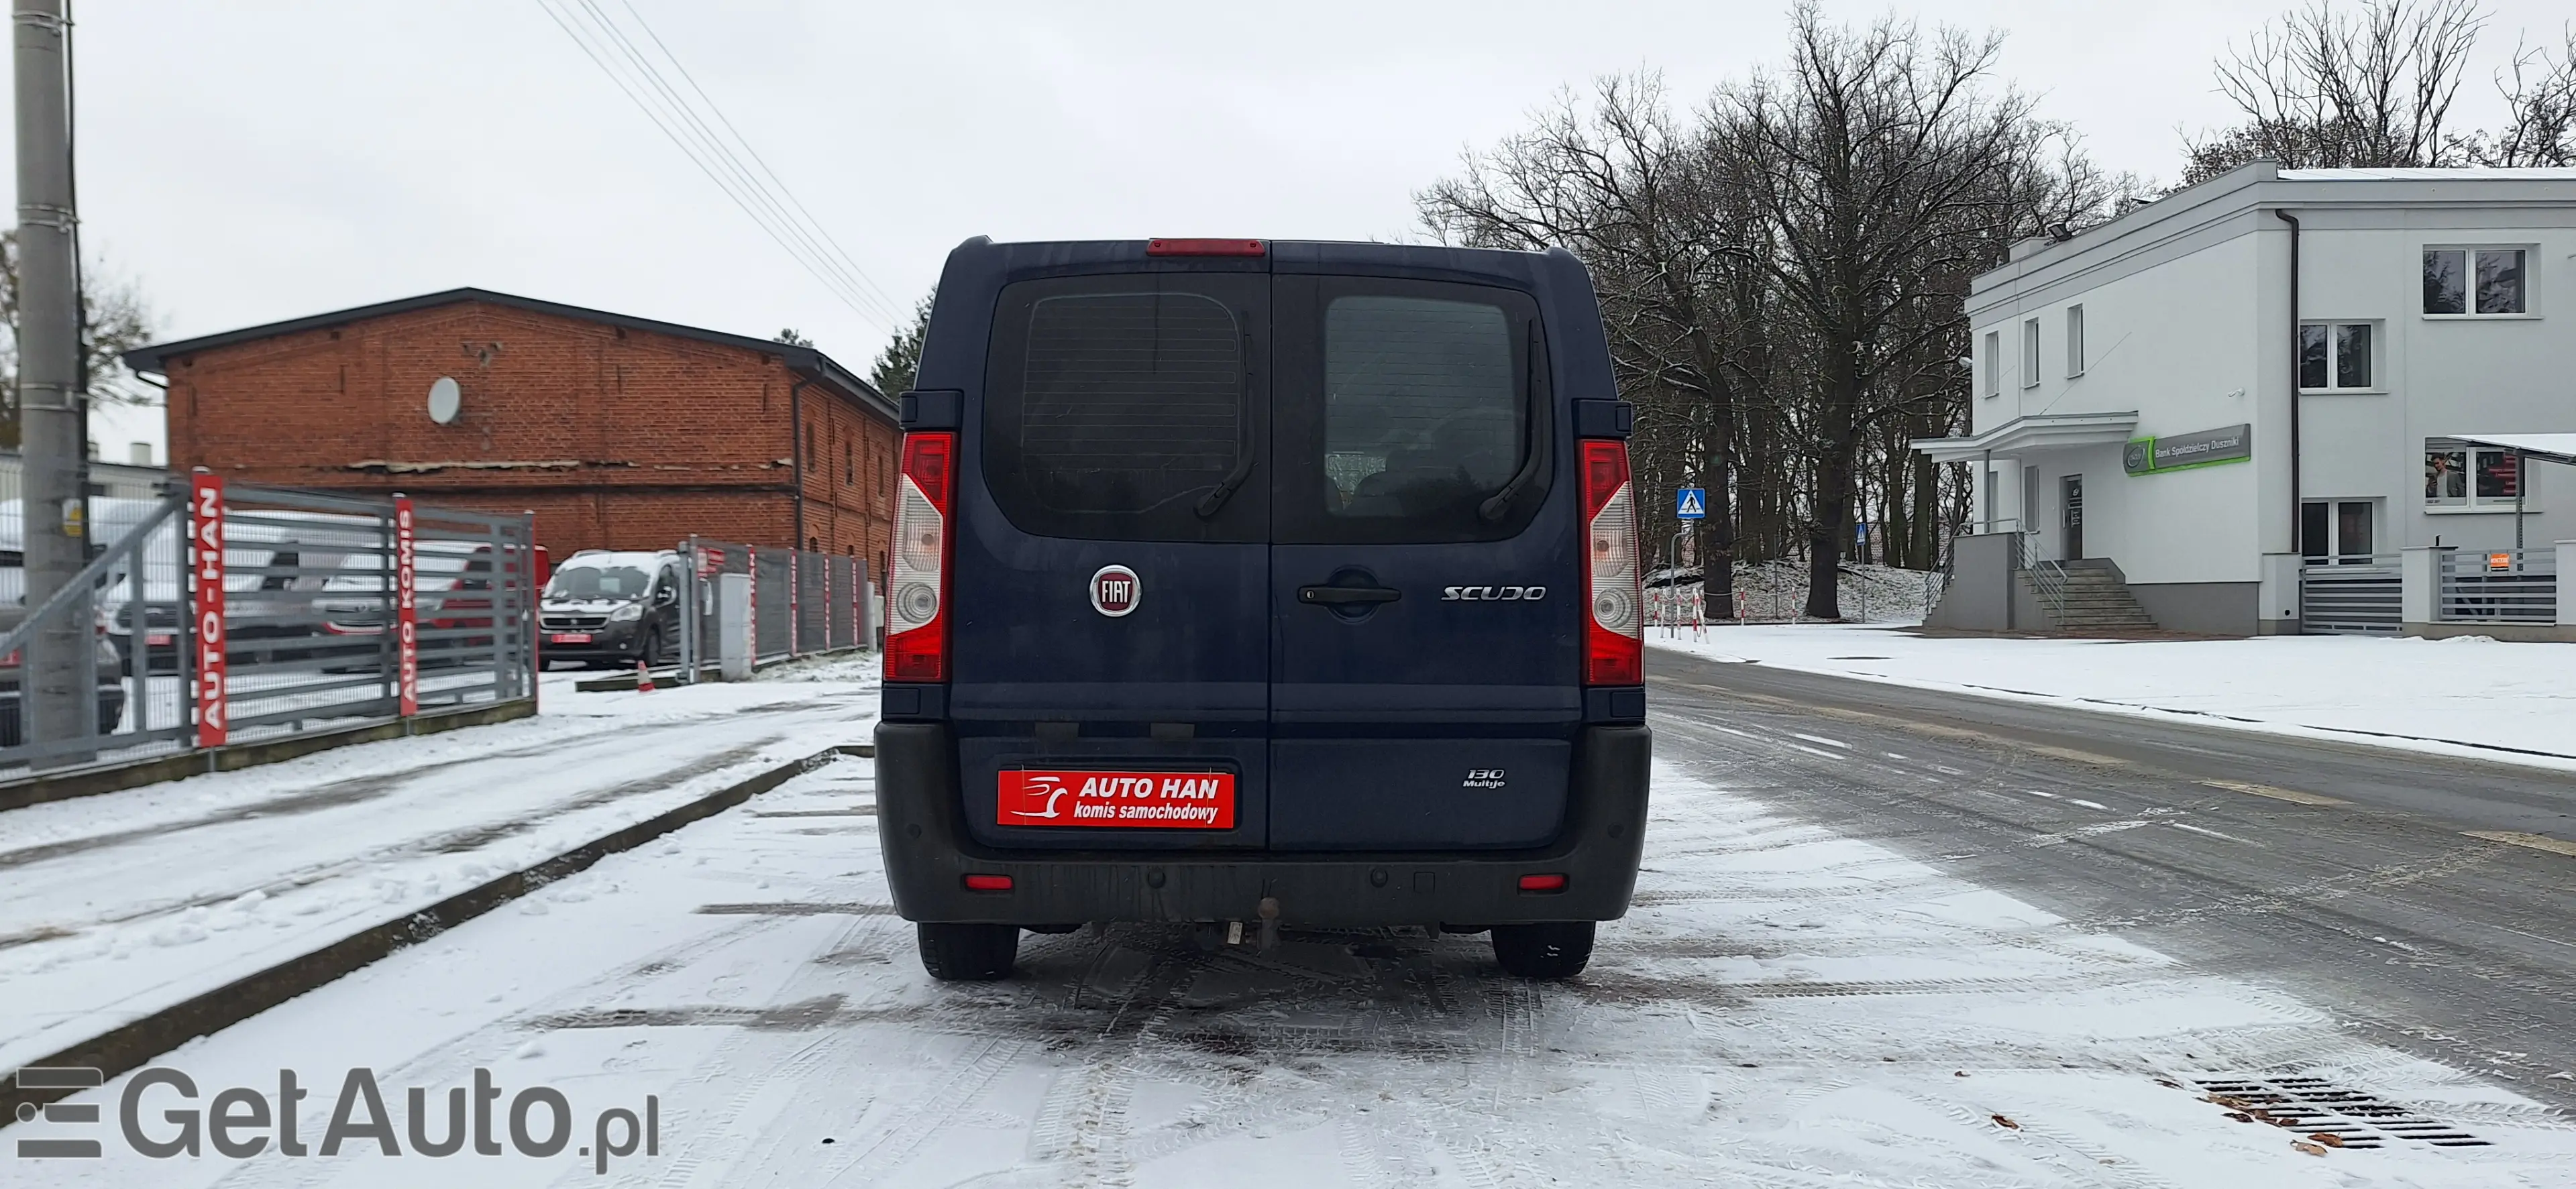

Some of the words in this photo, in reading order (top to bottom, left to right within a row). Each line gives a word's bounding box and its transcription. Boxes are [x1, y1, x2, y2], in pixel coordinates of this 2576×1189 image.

[2155, 447, 2170, 458] Bank
[2211, 437, 2239, 449] Duszniki
[399, 510, 412, 609] KOMIS
[1102, 581, 1130, 603] FIAT
[1441, 587, 1546, 600] SCUDO
[403, 620, 415, 701] AUTO
[1468, 769, 1505, 779] 130
[1079, 777, 1153, 799] AUTO
[1161, 779, 1218, 799] HAN
[1073, 801, 1116, 818] komis
[1119, 803, 1218, 824] samochodowy
